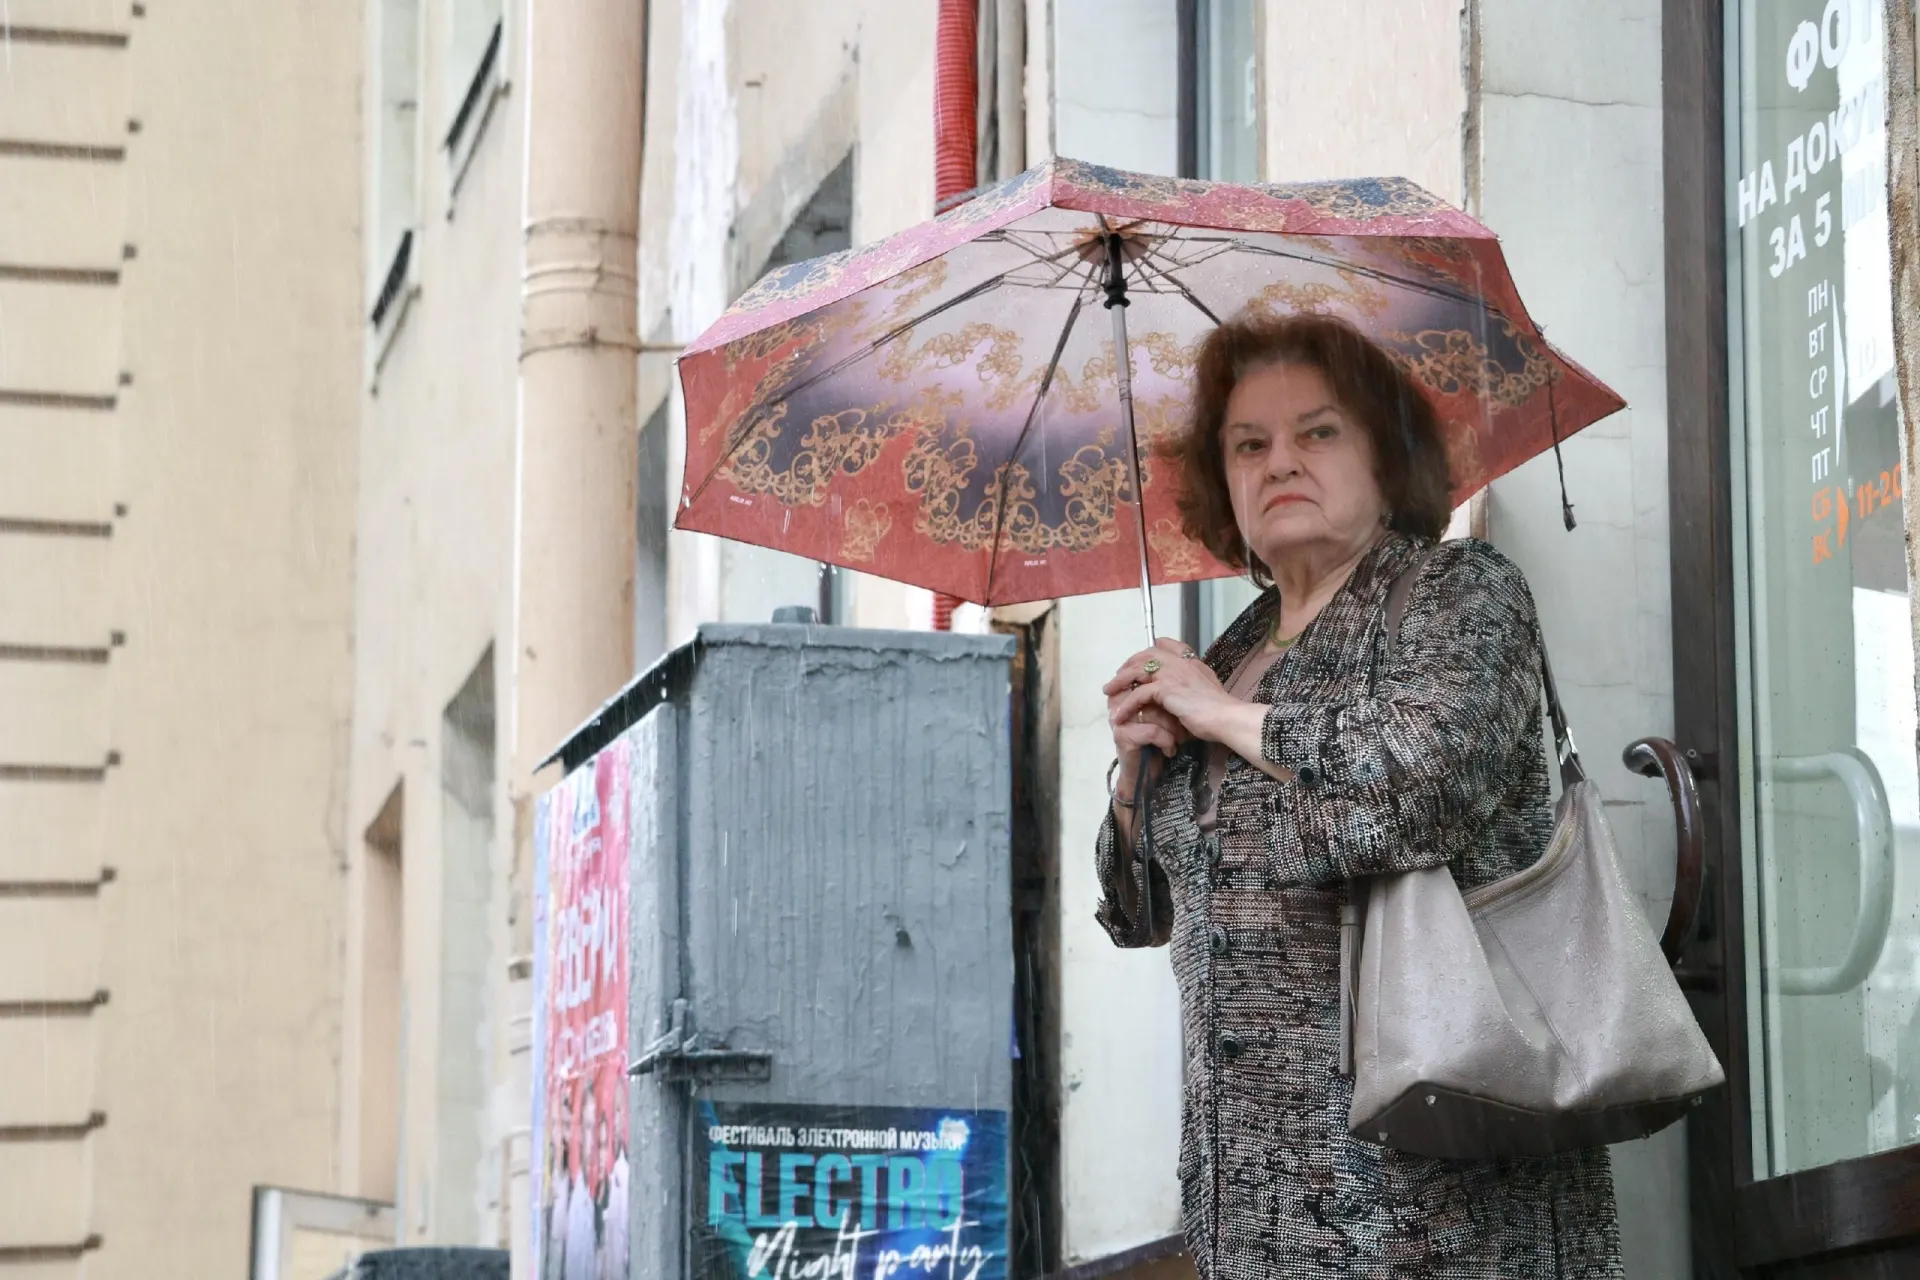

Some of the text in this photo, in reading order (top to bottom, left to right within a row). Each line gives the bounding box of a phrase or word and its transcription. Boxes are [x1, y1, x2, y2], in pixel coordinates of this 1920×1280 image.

[1738, 160, 1777, 228] НА
[1769, 214, 1806, 278] ЗА
[1814, 191, 1832, 248] 5
[1808, 280, 1828, 317] ПН
[1808, 321, 1827, 359] ВТ
[1810, 365, 1828, 399] СР
[1810, 405, 1829, 439] ЧТ
[1812, 447, 1831, 483] ПТ
[708, 1124, 795, 1146] ФЕСТИВАЛЬ
[798, 1126, 897, 1149] ЭЛЕКТРОННОЙ
[707, 1150, 964, 1231] ELECTRO
[746, 1208, 993, 1280] Night party
